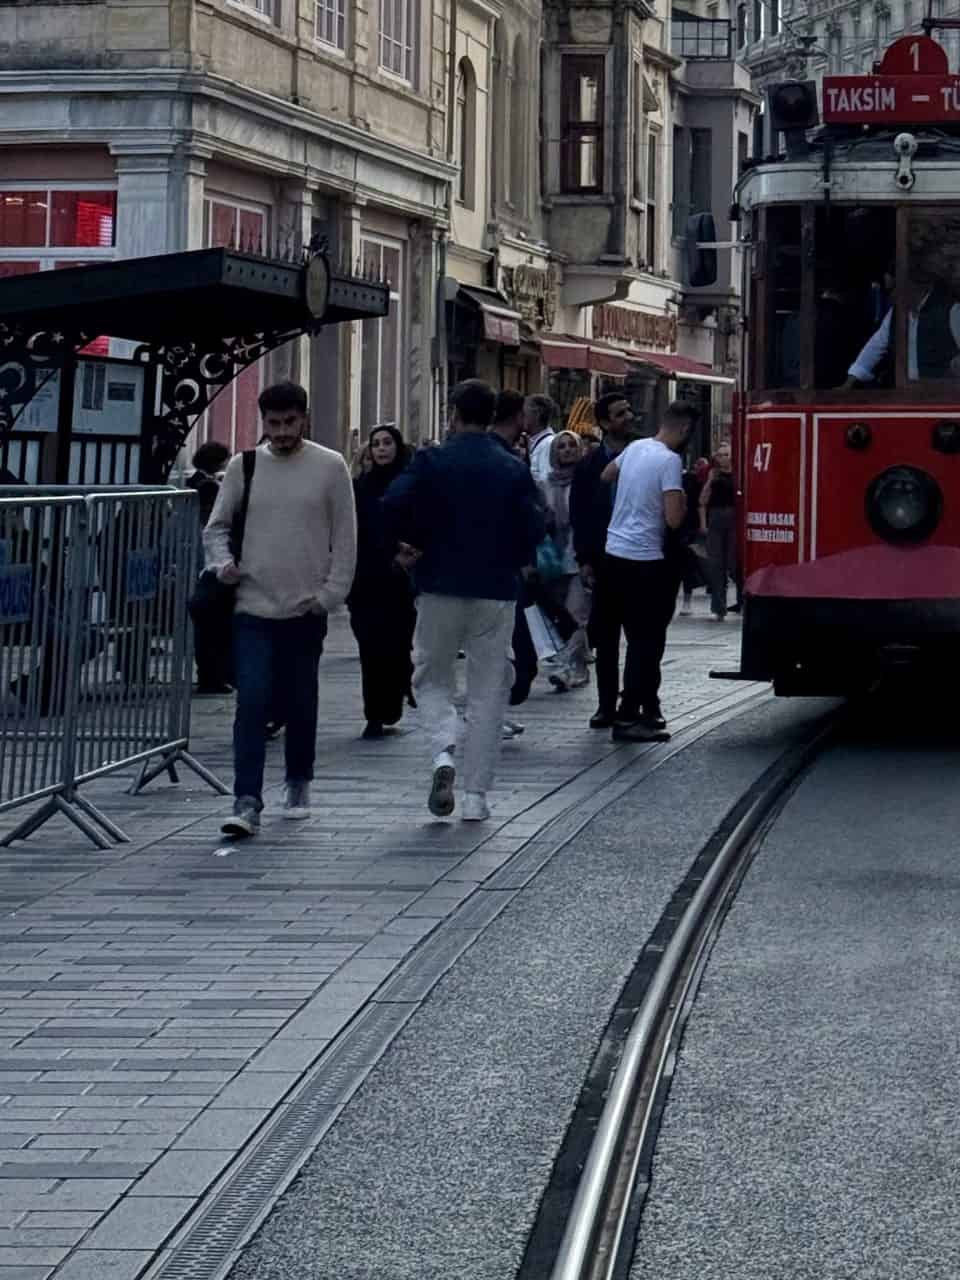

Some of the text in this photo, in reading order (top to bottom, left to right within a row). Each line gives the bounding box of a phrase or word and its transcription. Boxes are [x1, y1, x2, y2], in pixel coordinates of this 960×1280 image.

[910, 41, 920, 72] 1
[827, 82, 896, 112] TAKSİM
[753, 442, 773, 472] 47
